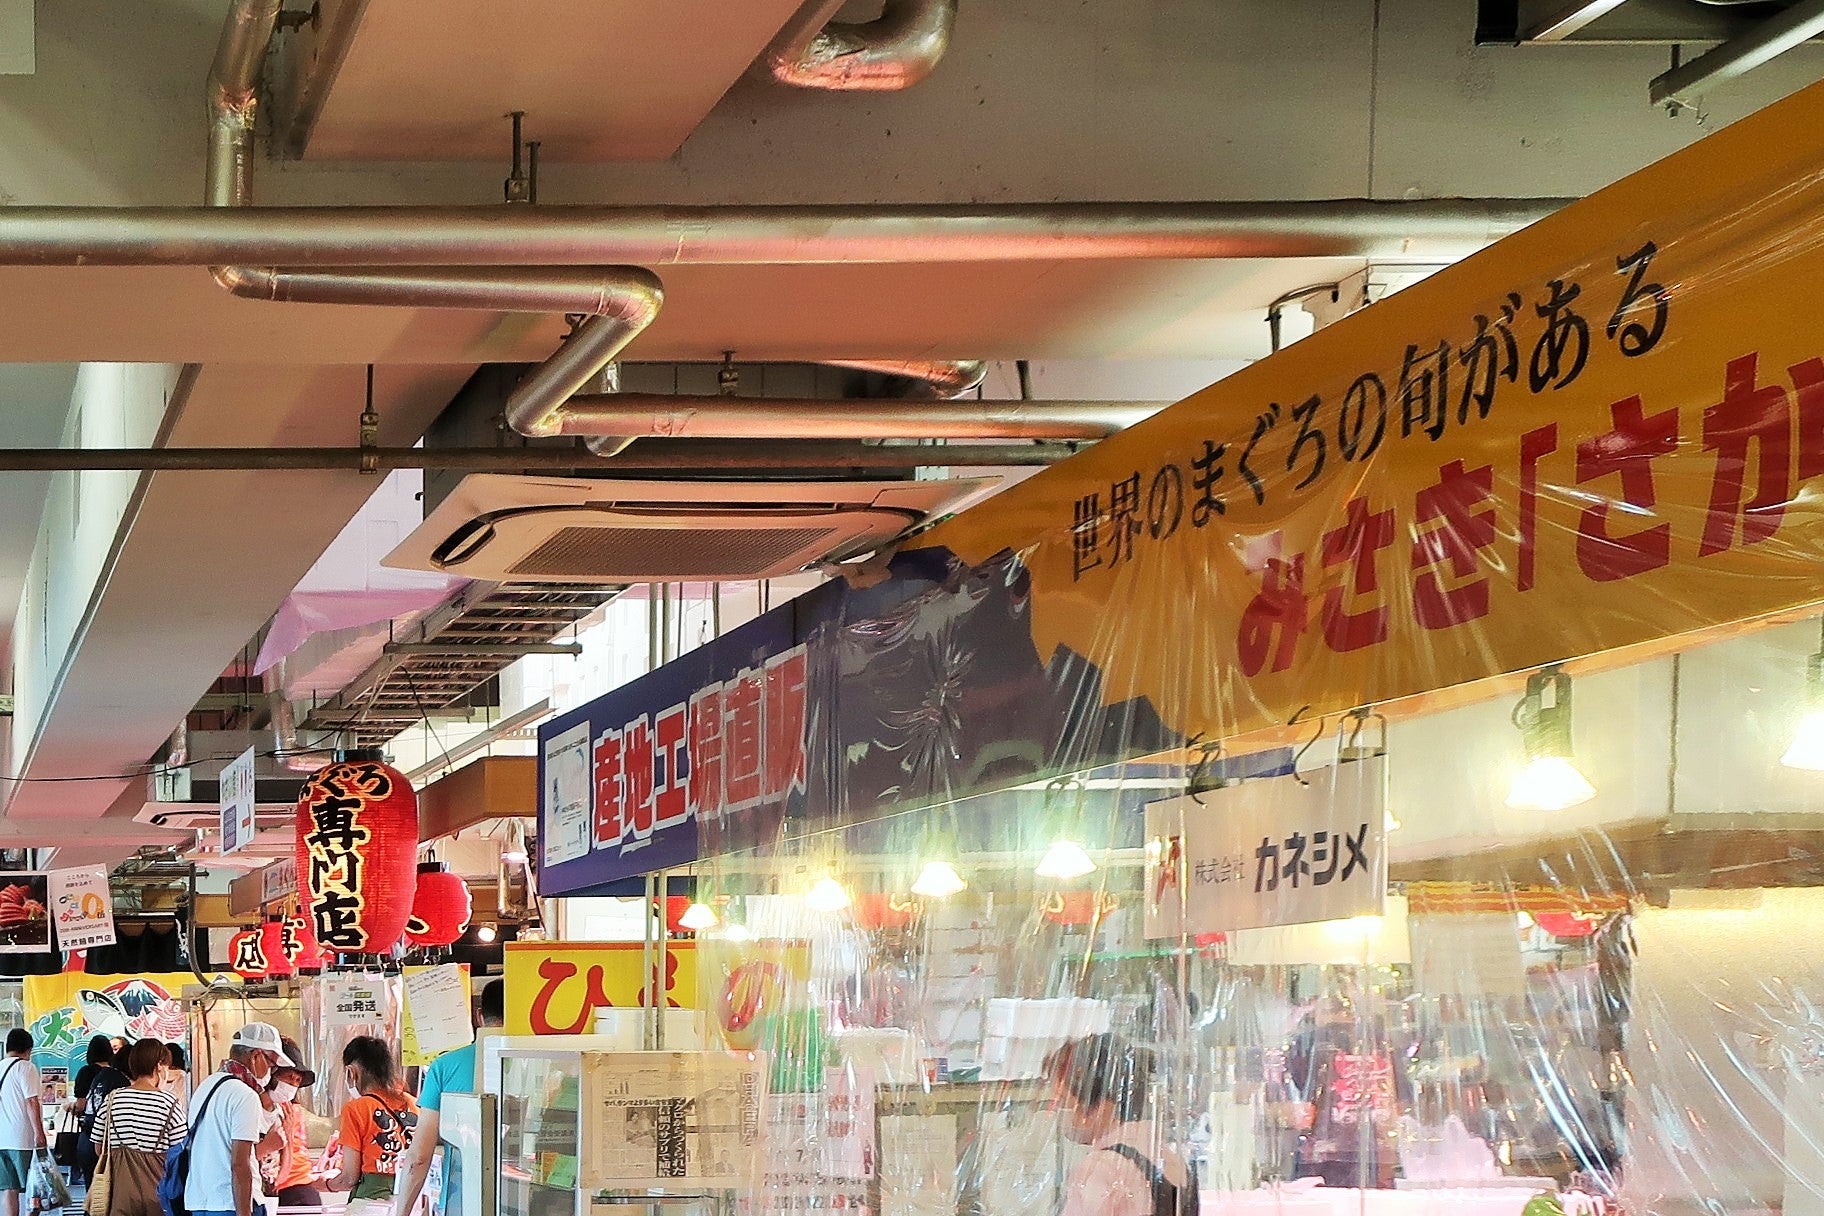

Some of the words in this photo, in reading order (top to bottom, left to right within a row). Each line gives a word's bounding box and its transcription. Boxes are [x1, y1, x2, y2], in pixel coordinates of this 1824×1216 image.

[1073, 241, 1670, 584] 世界のまぐろの旬がある
[308, 796, 367, 947] 専門店
[1254, 823, 1369, 893] カネシメ
[336, 1000, 377, 1012] 全国発送
